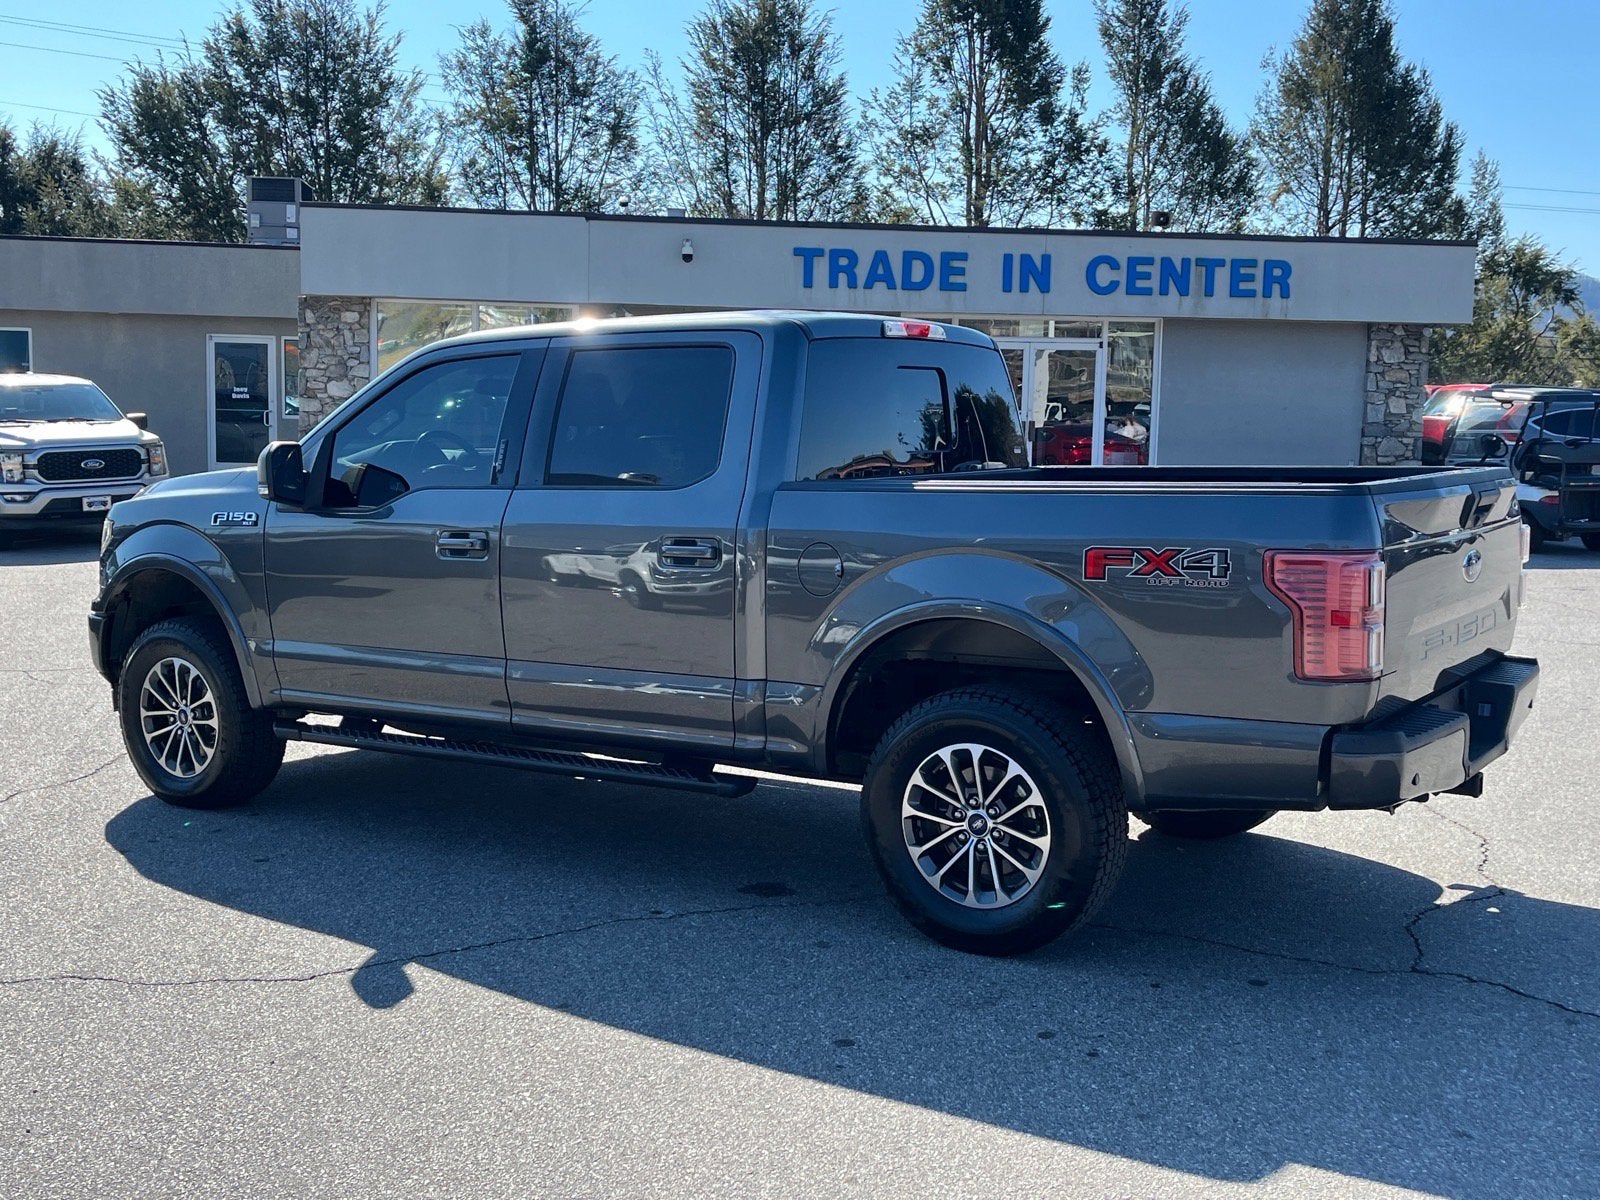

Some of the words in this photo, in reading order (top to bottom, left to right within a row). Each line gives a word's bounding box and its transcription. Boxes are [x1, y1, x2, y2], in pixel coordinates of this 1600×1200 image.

[793, 247, 969, 292] TRADE
[1002, 253, 1052, 294] IN
[1085, 254, 1293, 299] CENTER
[1082, 545, 1232, 582] FX4
[1146, 577, 1180, 586] OFF
[1185, 578, 1230, 587] ROAD
[1420, 607, 1497, 661] F-150
